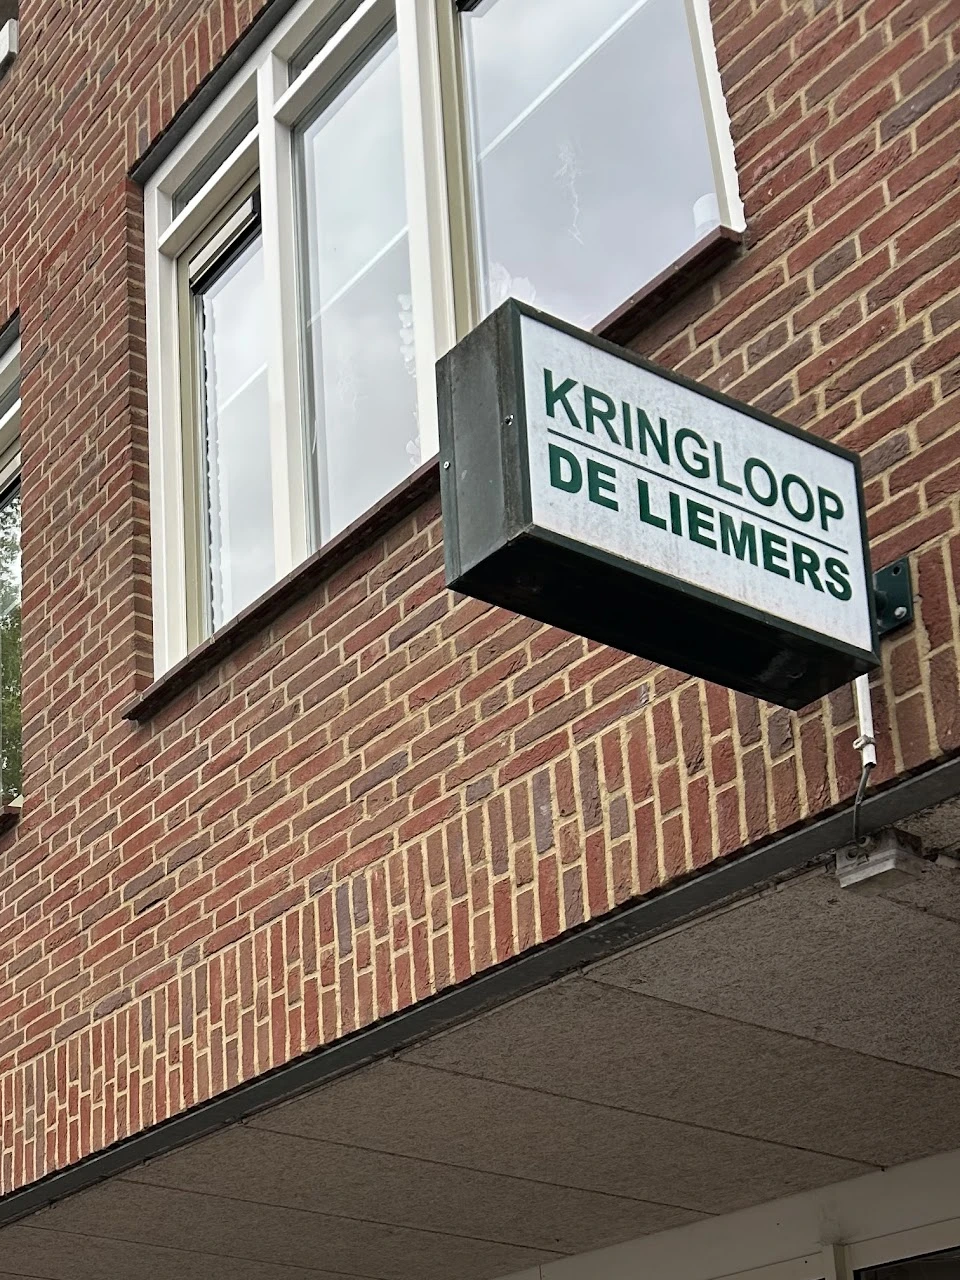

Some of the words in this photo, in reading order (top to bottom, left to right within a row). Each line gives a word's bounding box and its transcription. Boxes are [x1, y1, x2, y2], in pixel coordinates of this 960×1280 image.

[543, 368, 845, 532] KRINGLOOP
[548, 443, 619, 512] DE
[637, 478, 853, 602] LIEMERS
